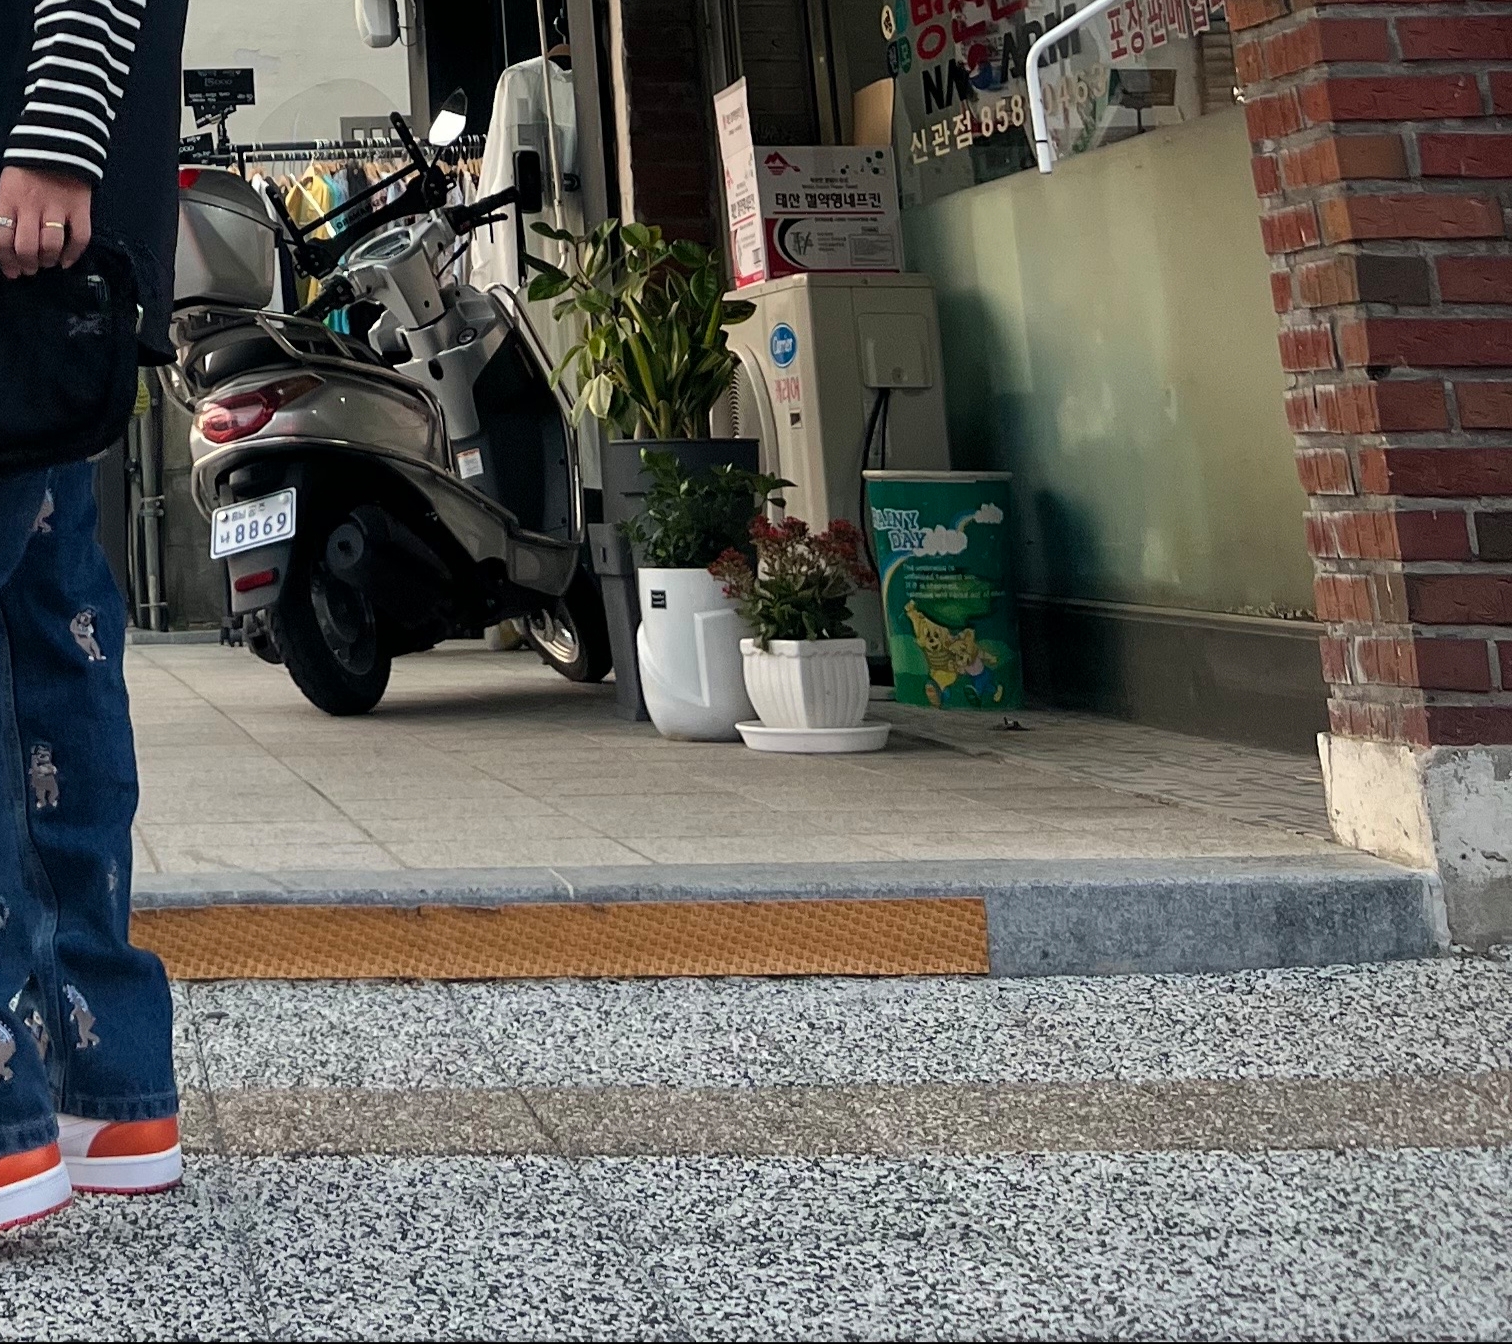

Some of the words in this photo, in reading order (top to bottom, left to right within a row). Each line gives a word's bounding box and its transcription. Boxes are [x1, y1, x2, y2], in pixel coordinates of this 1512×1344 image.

[910, 110, 974, 164] 신관점
[775, 192, 800, 208] 태산
[890, 529, 926, 550] DAY
